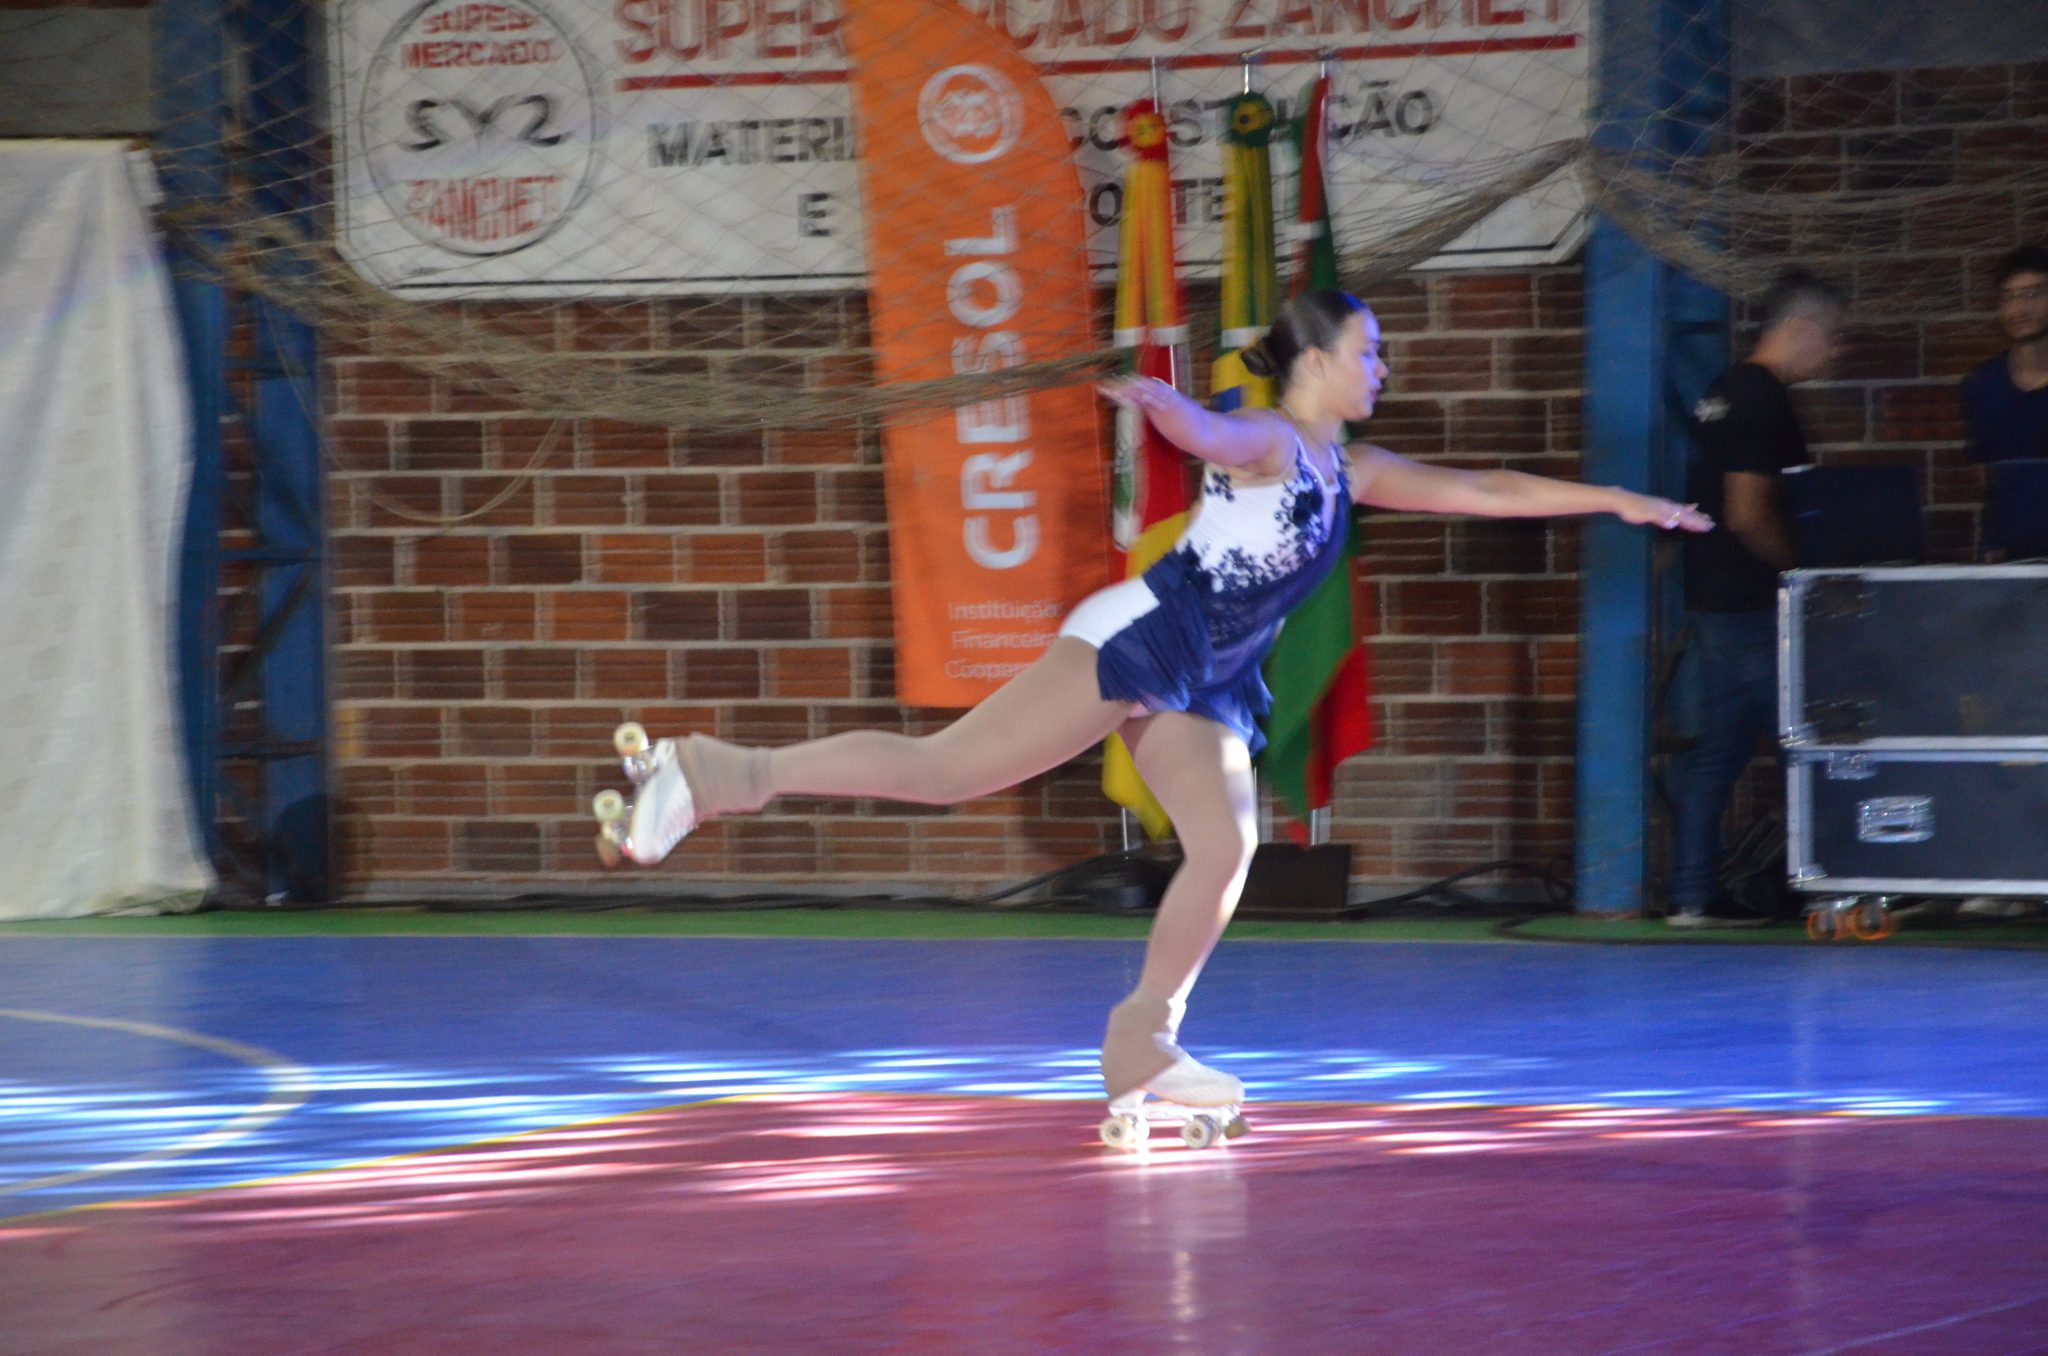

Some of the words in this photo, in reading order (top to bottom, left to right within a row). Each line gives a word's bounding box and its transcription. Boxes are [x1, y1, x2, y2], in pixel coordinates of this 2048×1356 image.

[401, 39, 562, 70] MERCADO
[798, 191, 836, 237] E
[944, 206, 1040, 571] CRESOL
